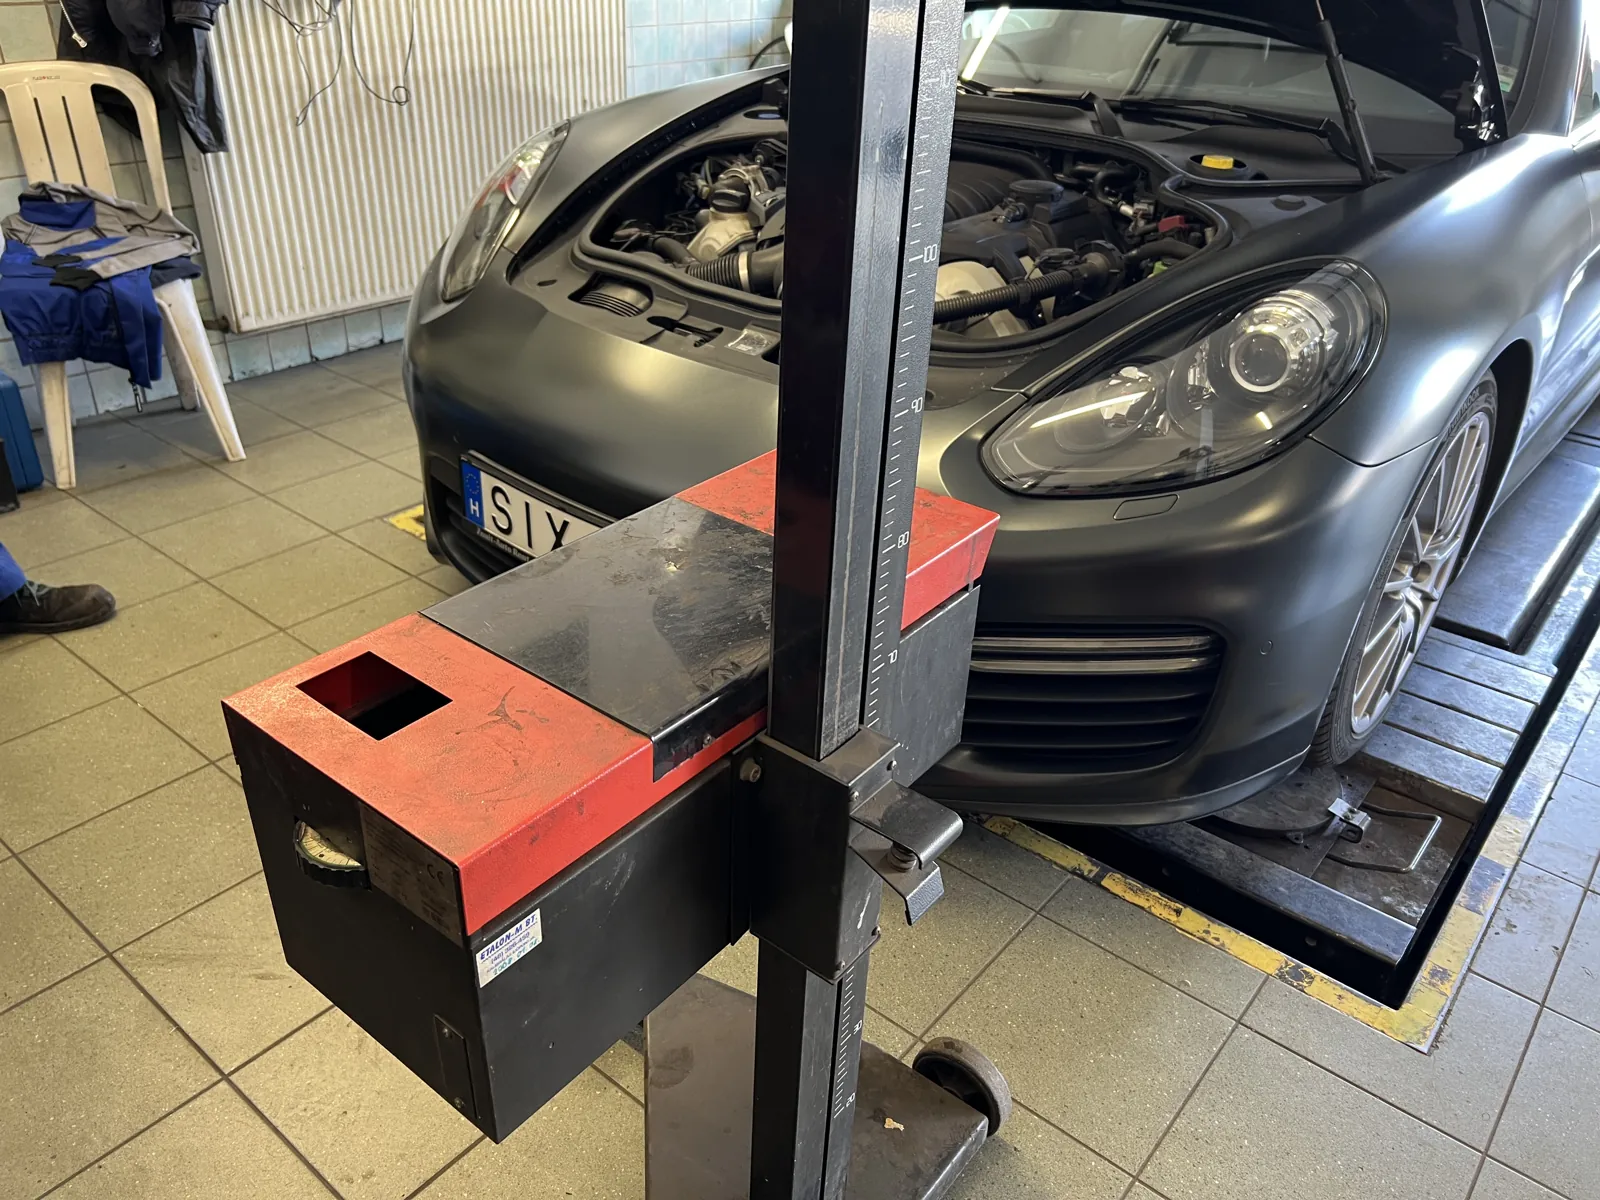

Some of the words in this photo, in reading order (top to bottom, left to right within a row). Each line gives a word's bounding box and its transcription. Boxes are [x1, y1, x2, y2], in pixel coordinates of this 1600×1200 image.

[911, 397, 923, 413] 90
[469, 498, 480, 518] H
[897, 531, 909, 548] 80
[888, 649, 898, 663] 70
[480, 924, 523, 960] ETALON-M
[525, 914, 538, 927] BT.
[853, 1020, 863, 1034] 30
[846, 1092, 856, 1107] 20
